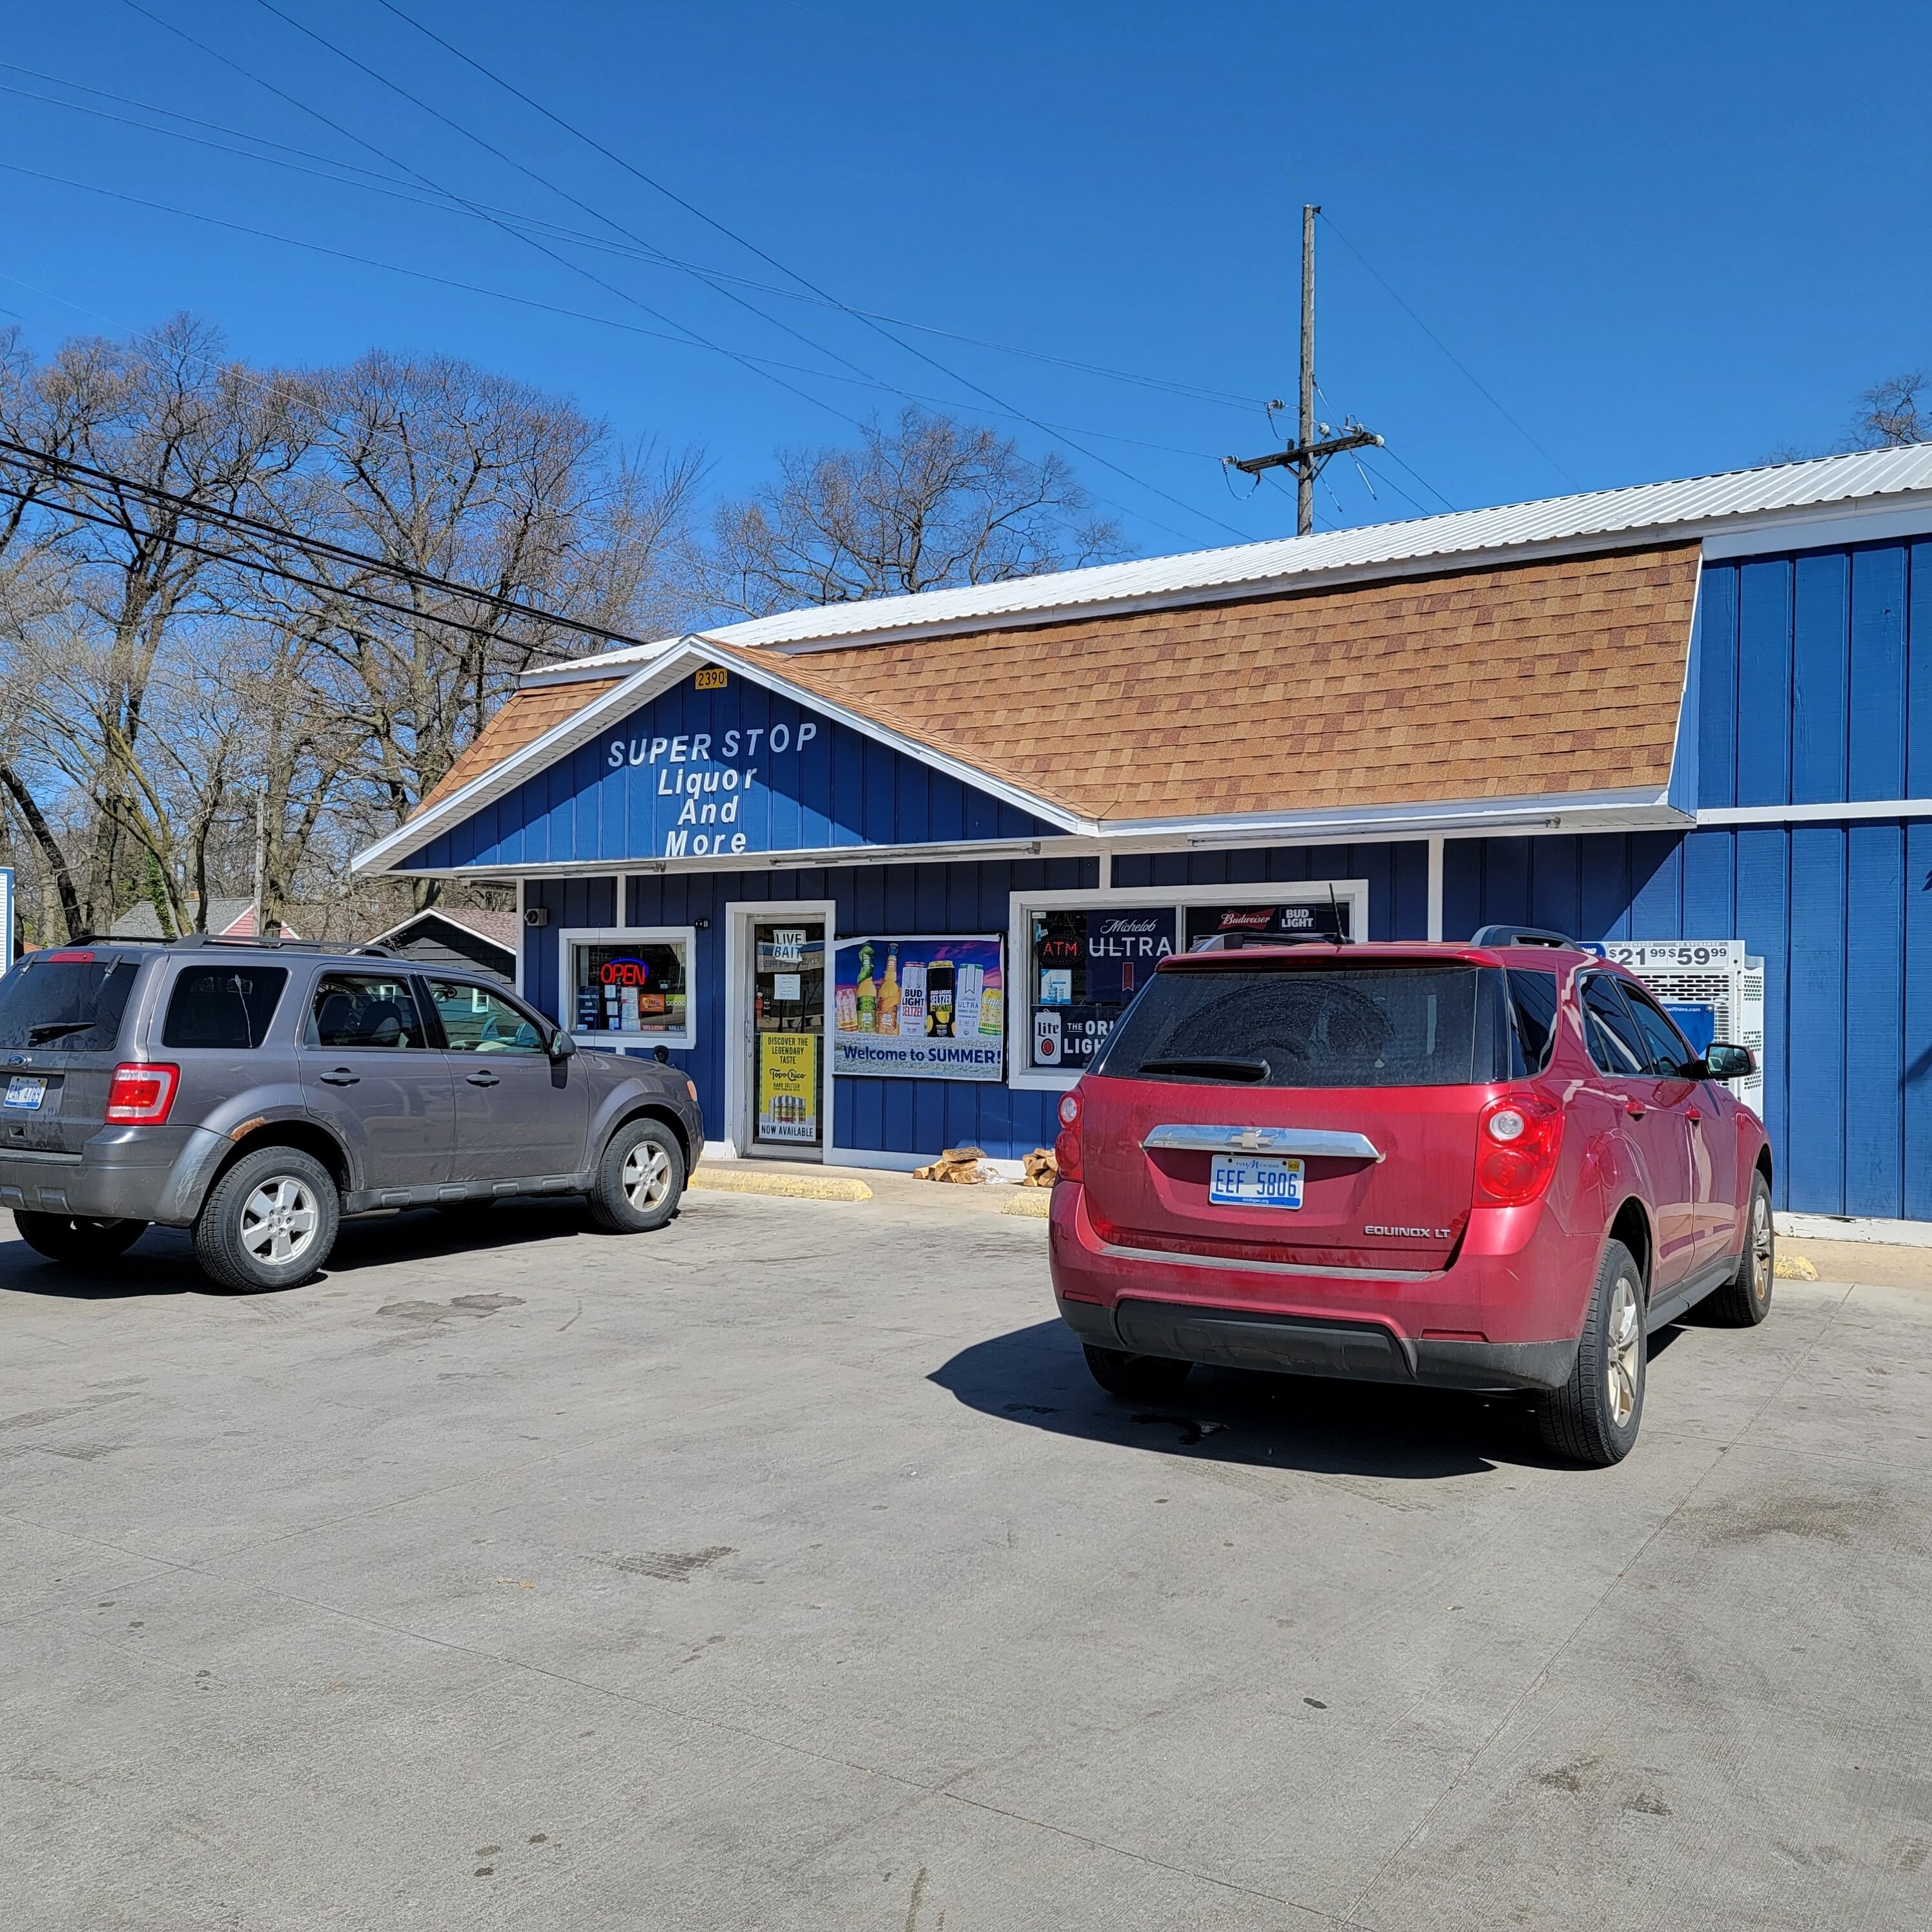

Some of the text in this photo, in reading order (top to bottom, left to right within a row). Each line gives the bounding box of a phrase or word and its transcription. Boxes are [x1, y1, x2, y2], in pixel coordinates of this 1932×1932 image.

[697, 670, 725, 686] 2390
[608, 723, 817, 767] SUPER STOP
[657, 767, 757, 800] Liquor
[677, 795, 739, 826] And
[665, 830, 746, 857] More
[1220, 913, 1271, 925] Budweiser
[1286, 909, 1310, 919] BUD
[1100, 919, 1158, 934] Michelob
[1281, 918, 1313, 928] LIGHT
[776, 933, 802, 945] LIVE
[774, 946, 800, 959] BAIT
[1043, 940, 1077, 956] ATM
[1089, 936, 1172, 956] ULTRA
[601, 963, 645, 985] OPEN
[905, 989, 923, 998] BUD
[930, 994, 952, 1005] SELTZER
[902, 997, 925, 1007] LIGHT
[930, 1004, 952, 1013] LEMONADE
[902, 1005, 923, 1017] SELTZER
[1036, 1022, 1059, 1038] Lite
[1067, 1020, 1115, 1036] THE ORI
[768, 1036, 809, 1046] DISCOVER THE
[1064, 1038, 1105, 1054] LIGH
[772, 1046, 804, 1055] LEGENDARY
[843, 1045, 1001, 1064] Welcome to SUMMER!
[779, 1056, 796, 1064] TASTE
[761, 1125, 813, 1137] NOW AVAILABLE
[1215, 1169, 1298, 1197] EEF 5806
[1364, 1225, 1451, 1238] EQUINOX LT
